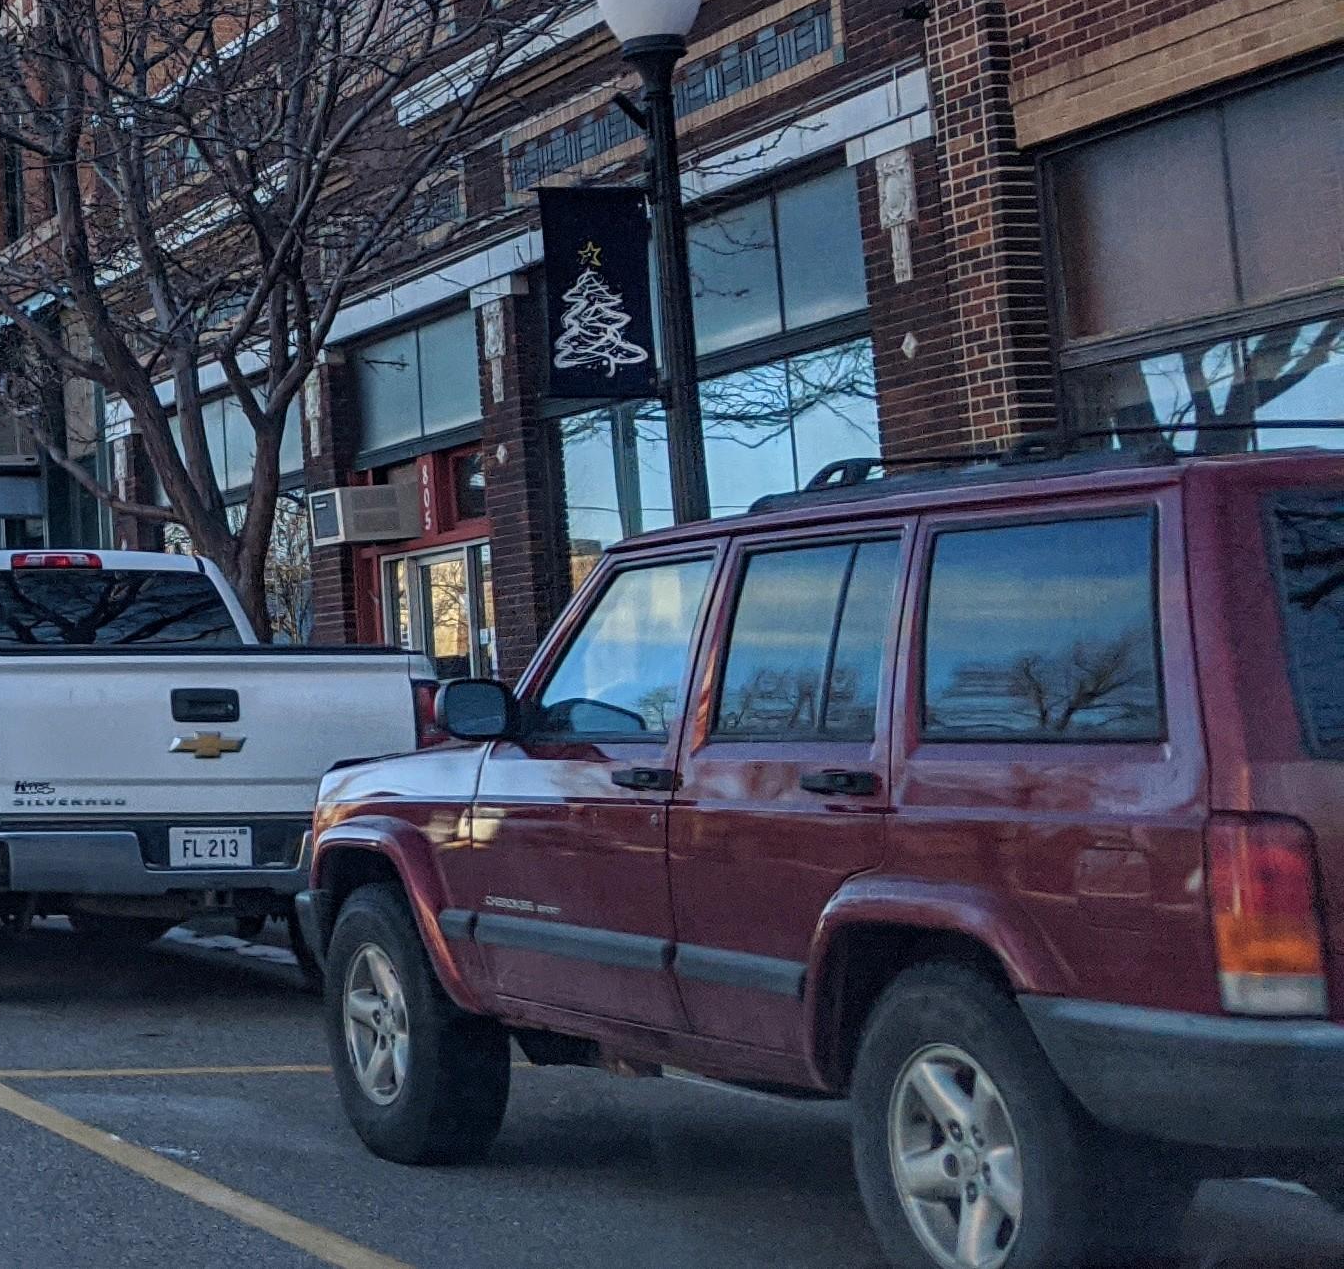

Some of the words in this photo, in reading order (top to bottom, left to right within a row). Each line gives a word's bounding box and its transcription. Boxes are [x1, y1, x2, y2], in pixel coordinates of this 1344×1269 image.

[422, 464, 432, 530] 805
[13, 799, 126, 807] SILVERADO
[183, 839, 203, 858] FL
[208, 839, 238, 858] 213
